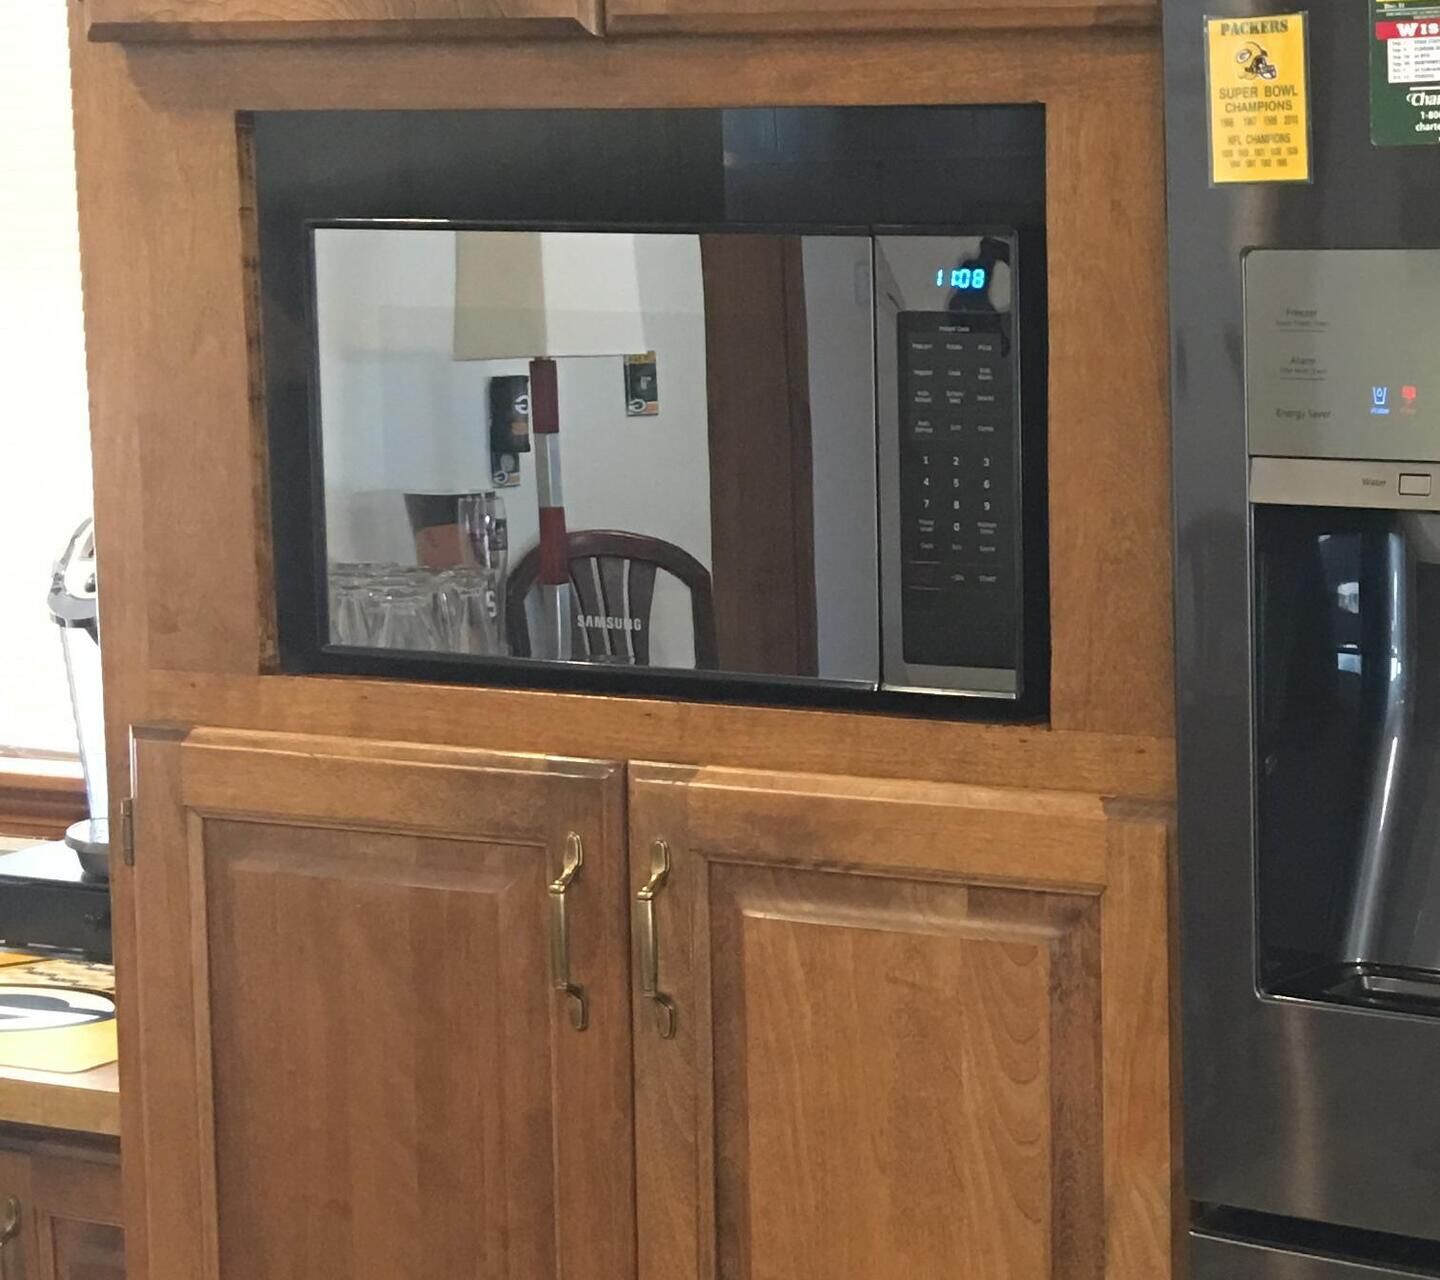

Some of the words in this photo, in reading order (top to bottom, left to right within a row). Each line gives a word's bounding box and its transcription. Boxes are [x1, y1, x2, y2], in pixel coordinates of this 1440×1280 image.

[1220, 19, 1289, 36] PACKERS
[1219, 86, 1259, 100] SUPER
[1264, 85, 1298, 97] BOWL
[1225, 100, 1293, 113] CHAMPIONS
[936, 268, 985, 289] 11:08
[923, 455, 929, 465] 1
[952, 456, 960, 466] 2
[983, 457, 990, 467] 3
[923, 477, 930, 486] 4
[952, 478, 960, 487] 5
[983, 479, 990, 489] 6
[1362, 478, 1387, 488] Water
[923, 498, 930, 508] 7
[953, 500, 960, 510] 8
[983, 501, 991, 511] 9
[953, 522, 960, 532] 0
[577, 614, 642, 632] SAMSUNG
